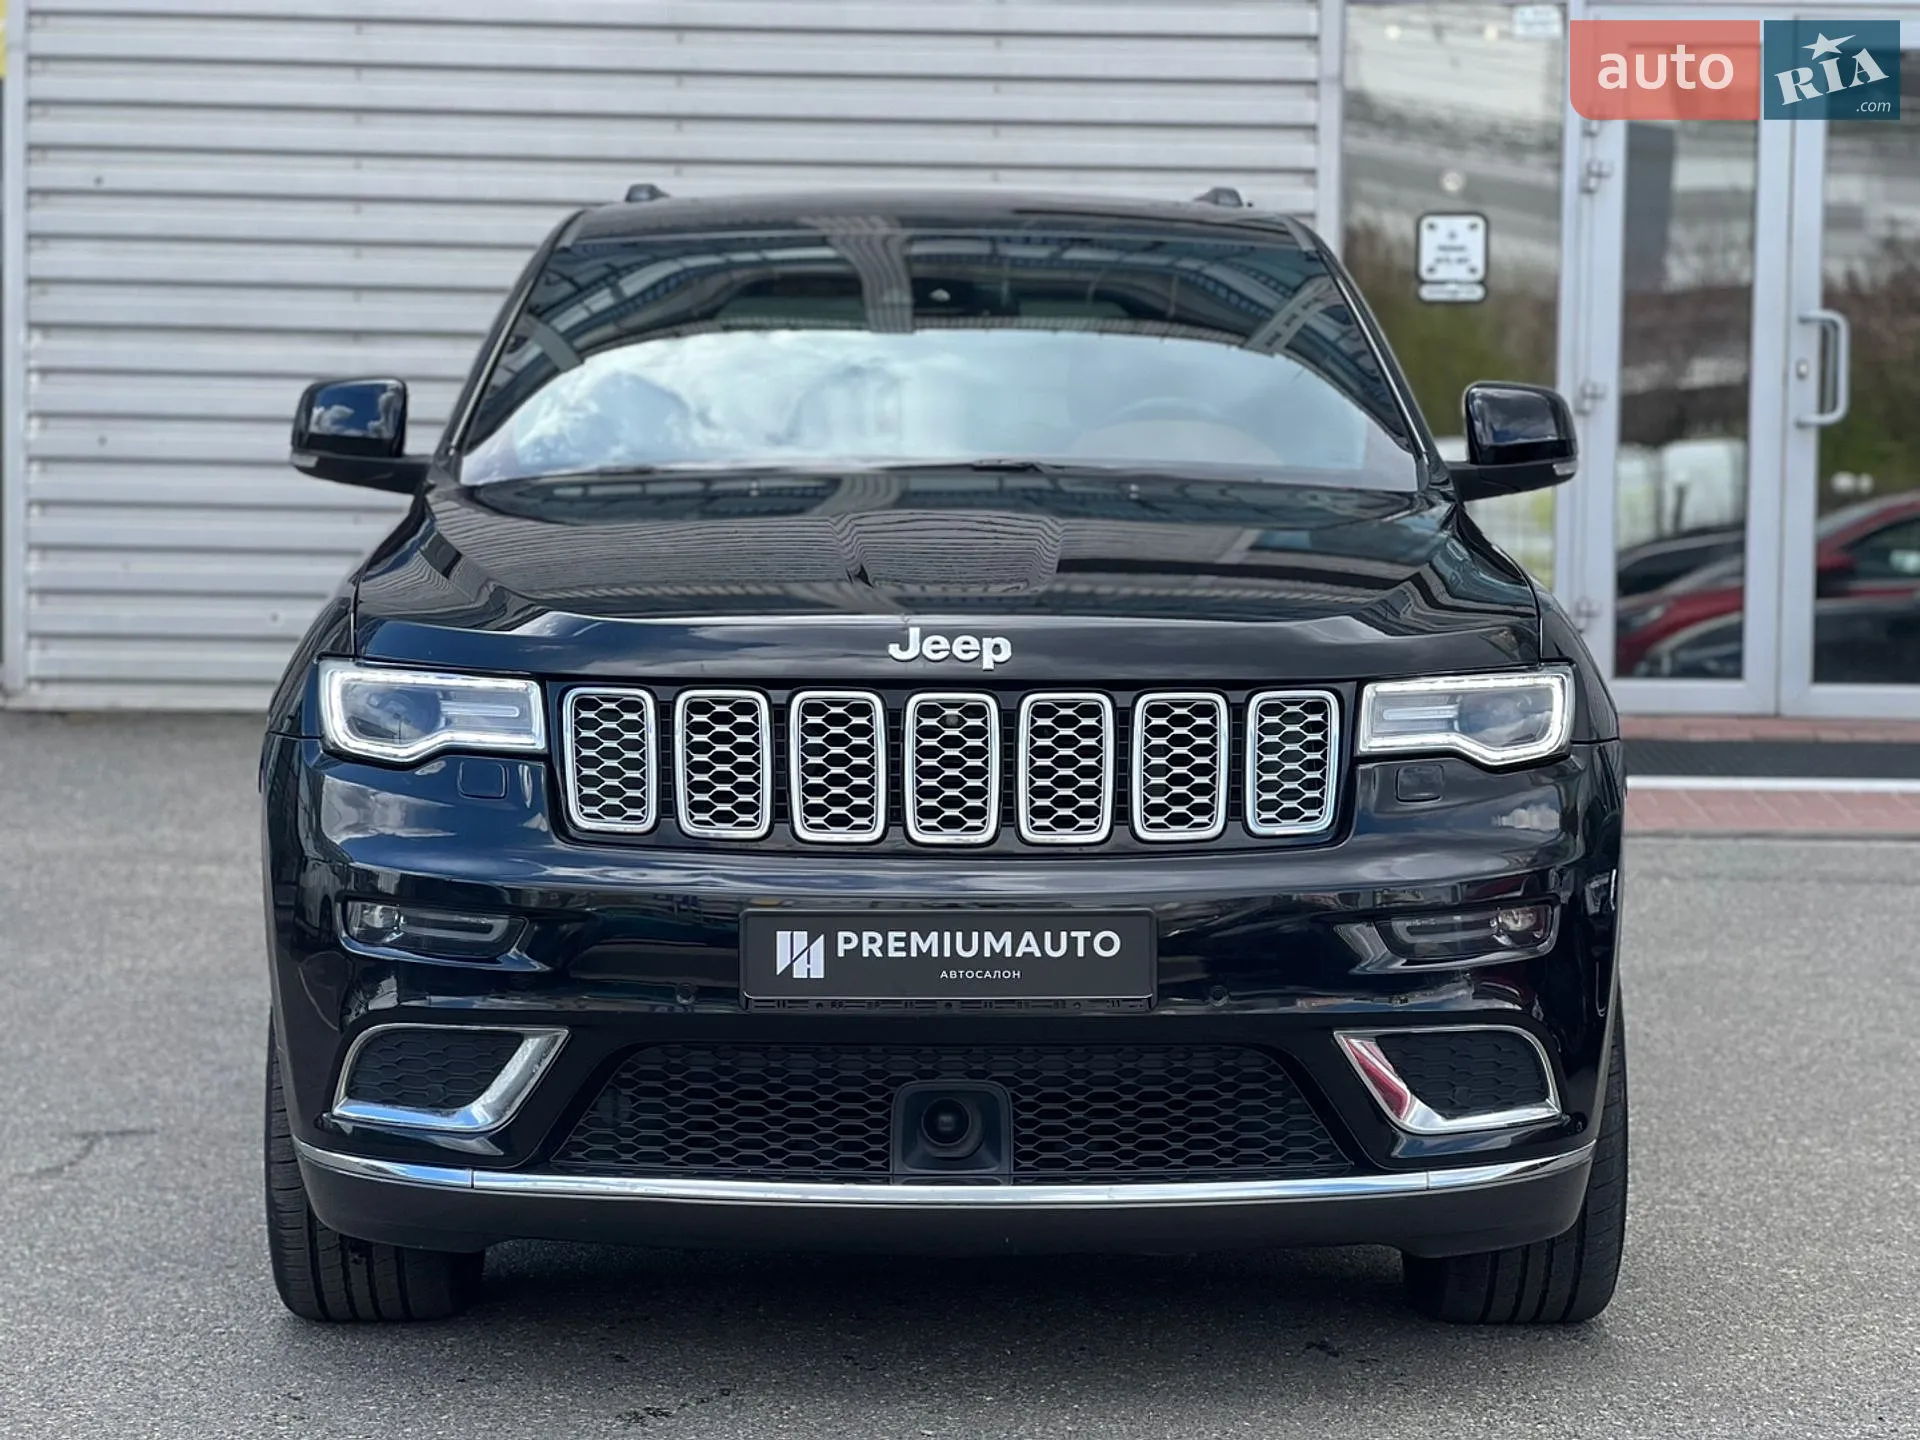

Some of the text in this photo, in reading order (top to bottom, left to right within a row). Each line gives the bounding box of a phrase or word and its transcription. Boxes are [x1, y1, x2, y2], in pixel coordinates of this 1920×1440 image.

[888, 627, 1012, 671] Jeep
[837, 930, 1121, 958] PREMIUMAUTO
[939, 969, 1021, 979] АВТОСАЛОН
